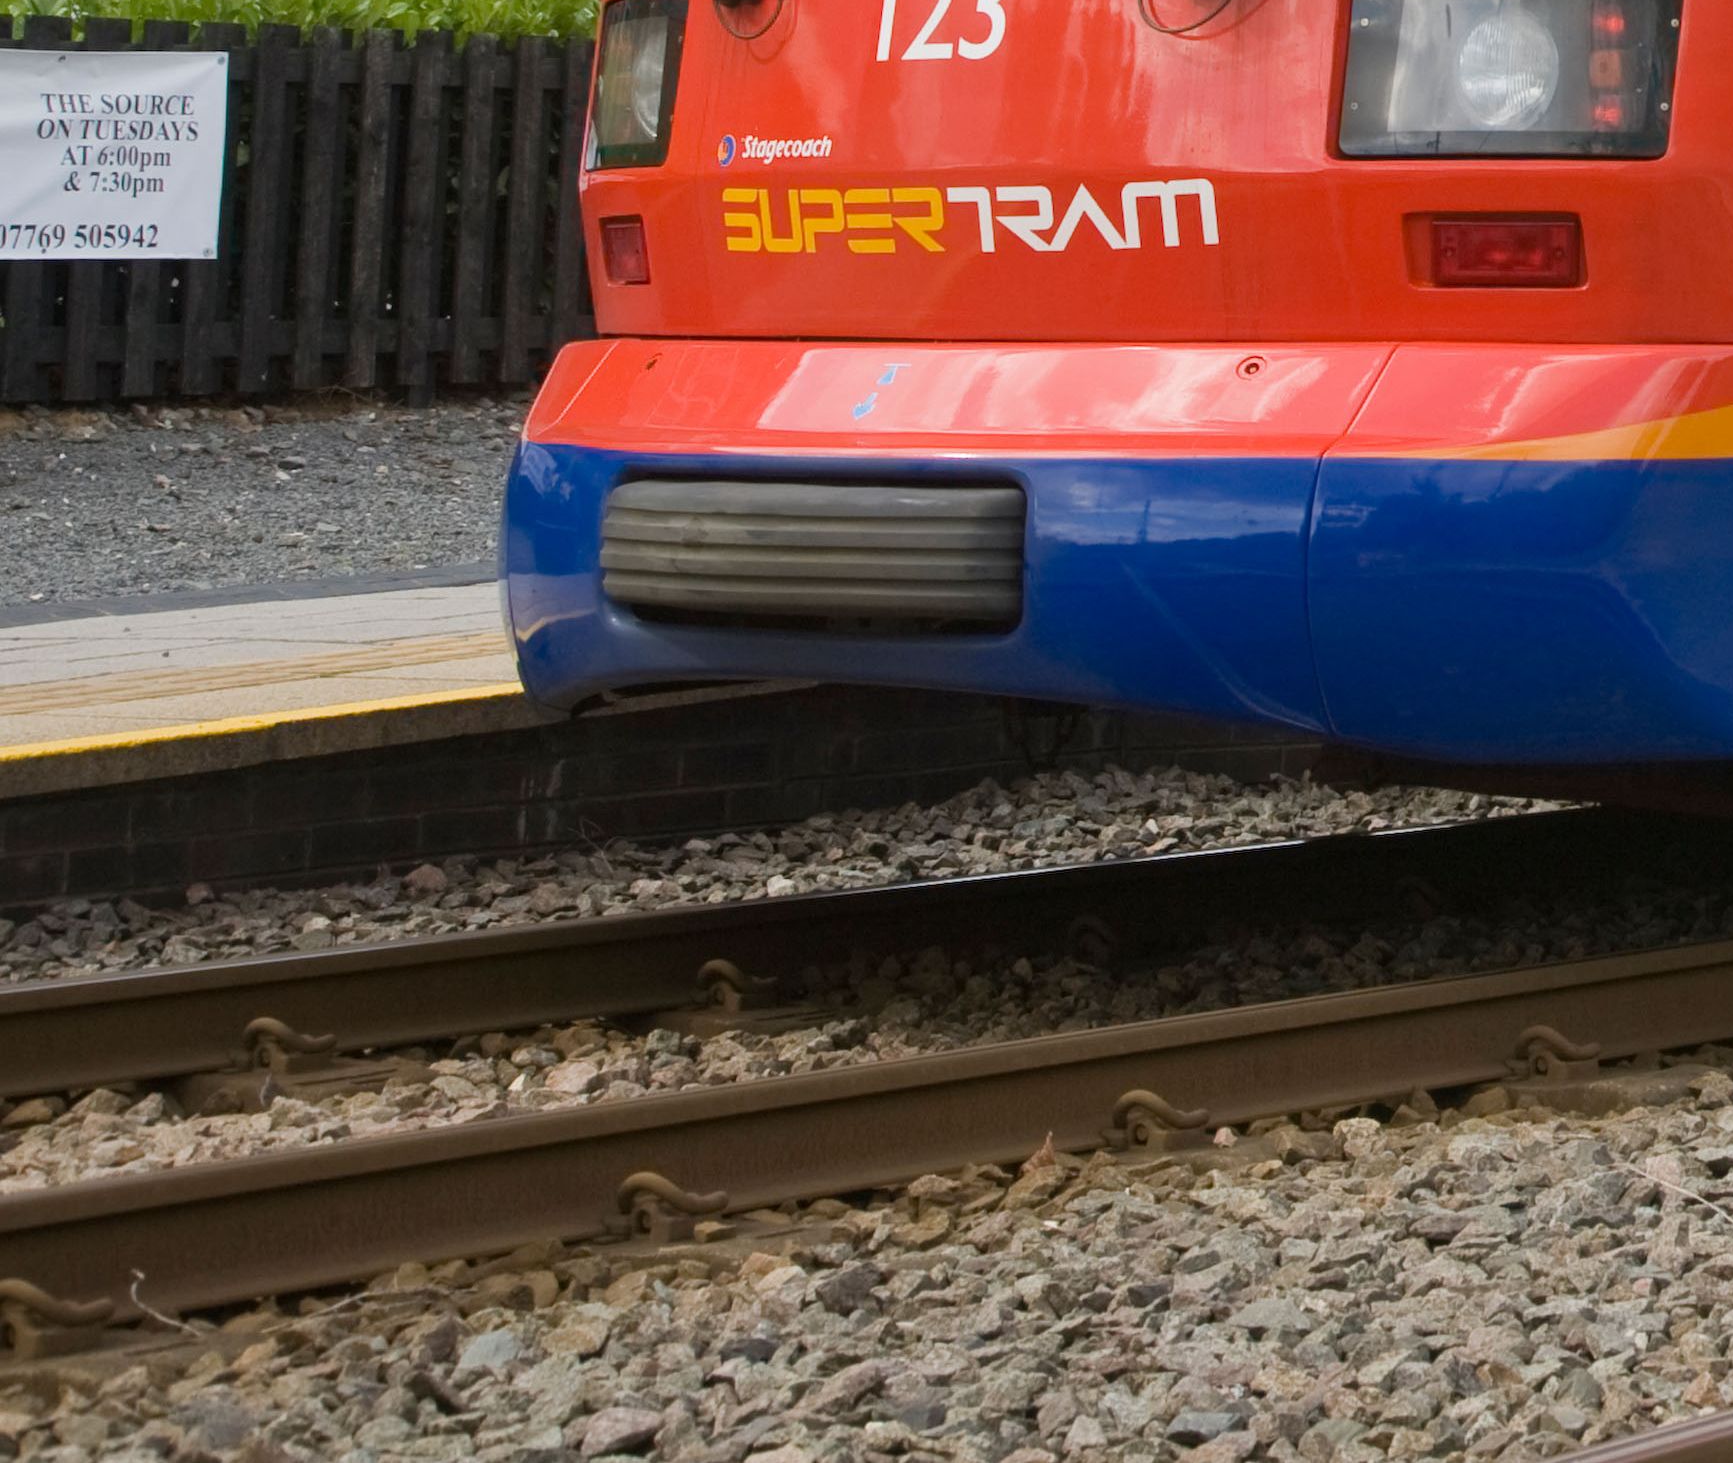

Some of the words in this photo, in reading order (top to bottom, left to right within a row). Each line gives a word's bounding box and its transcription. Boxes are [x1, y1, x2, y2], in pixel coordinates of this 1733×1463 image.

[41, 93, 97, 116] THE
[100, 93, 196, 117] SOURCE
[36, 118, 76, 140] ON
[79, 118, 199, 143] TUESDAYS
[60, 145, 93, 167] AT
[96, 145, 172, 171] 6:00pm
[741, 134, 833, 166] Stagecoach
[63, 171, 83, 193] &
[89, 170, 165, 198] 7:30pm
[722, 177, 1221, 254] SUPERTRAM
[73, 222, 160, 249] 505942
